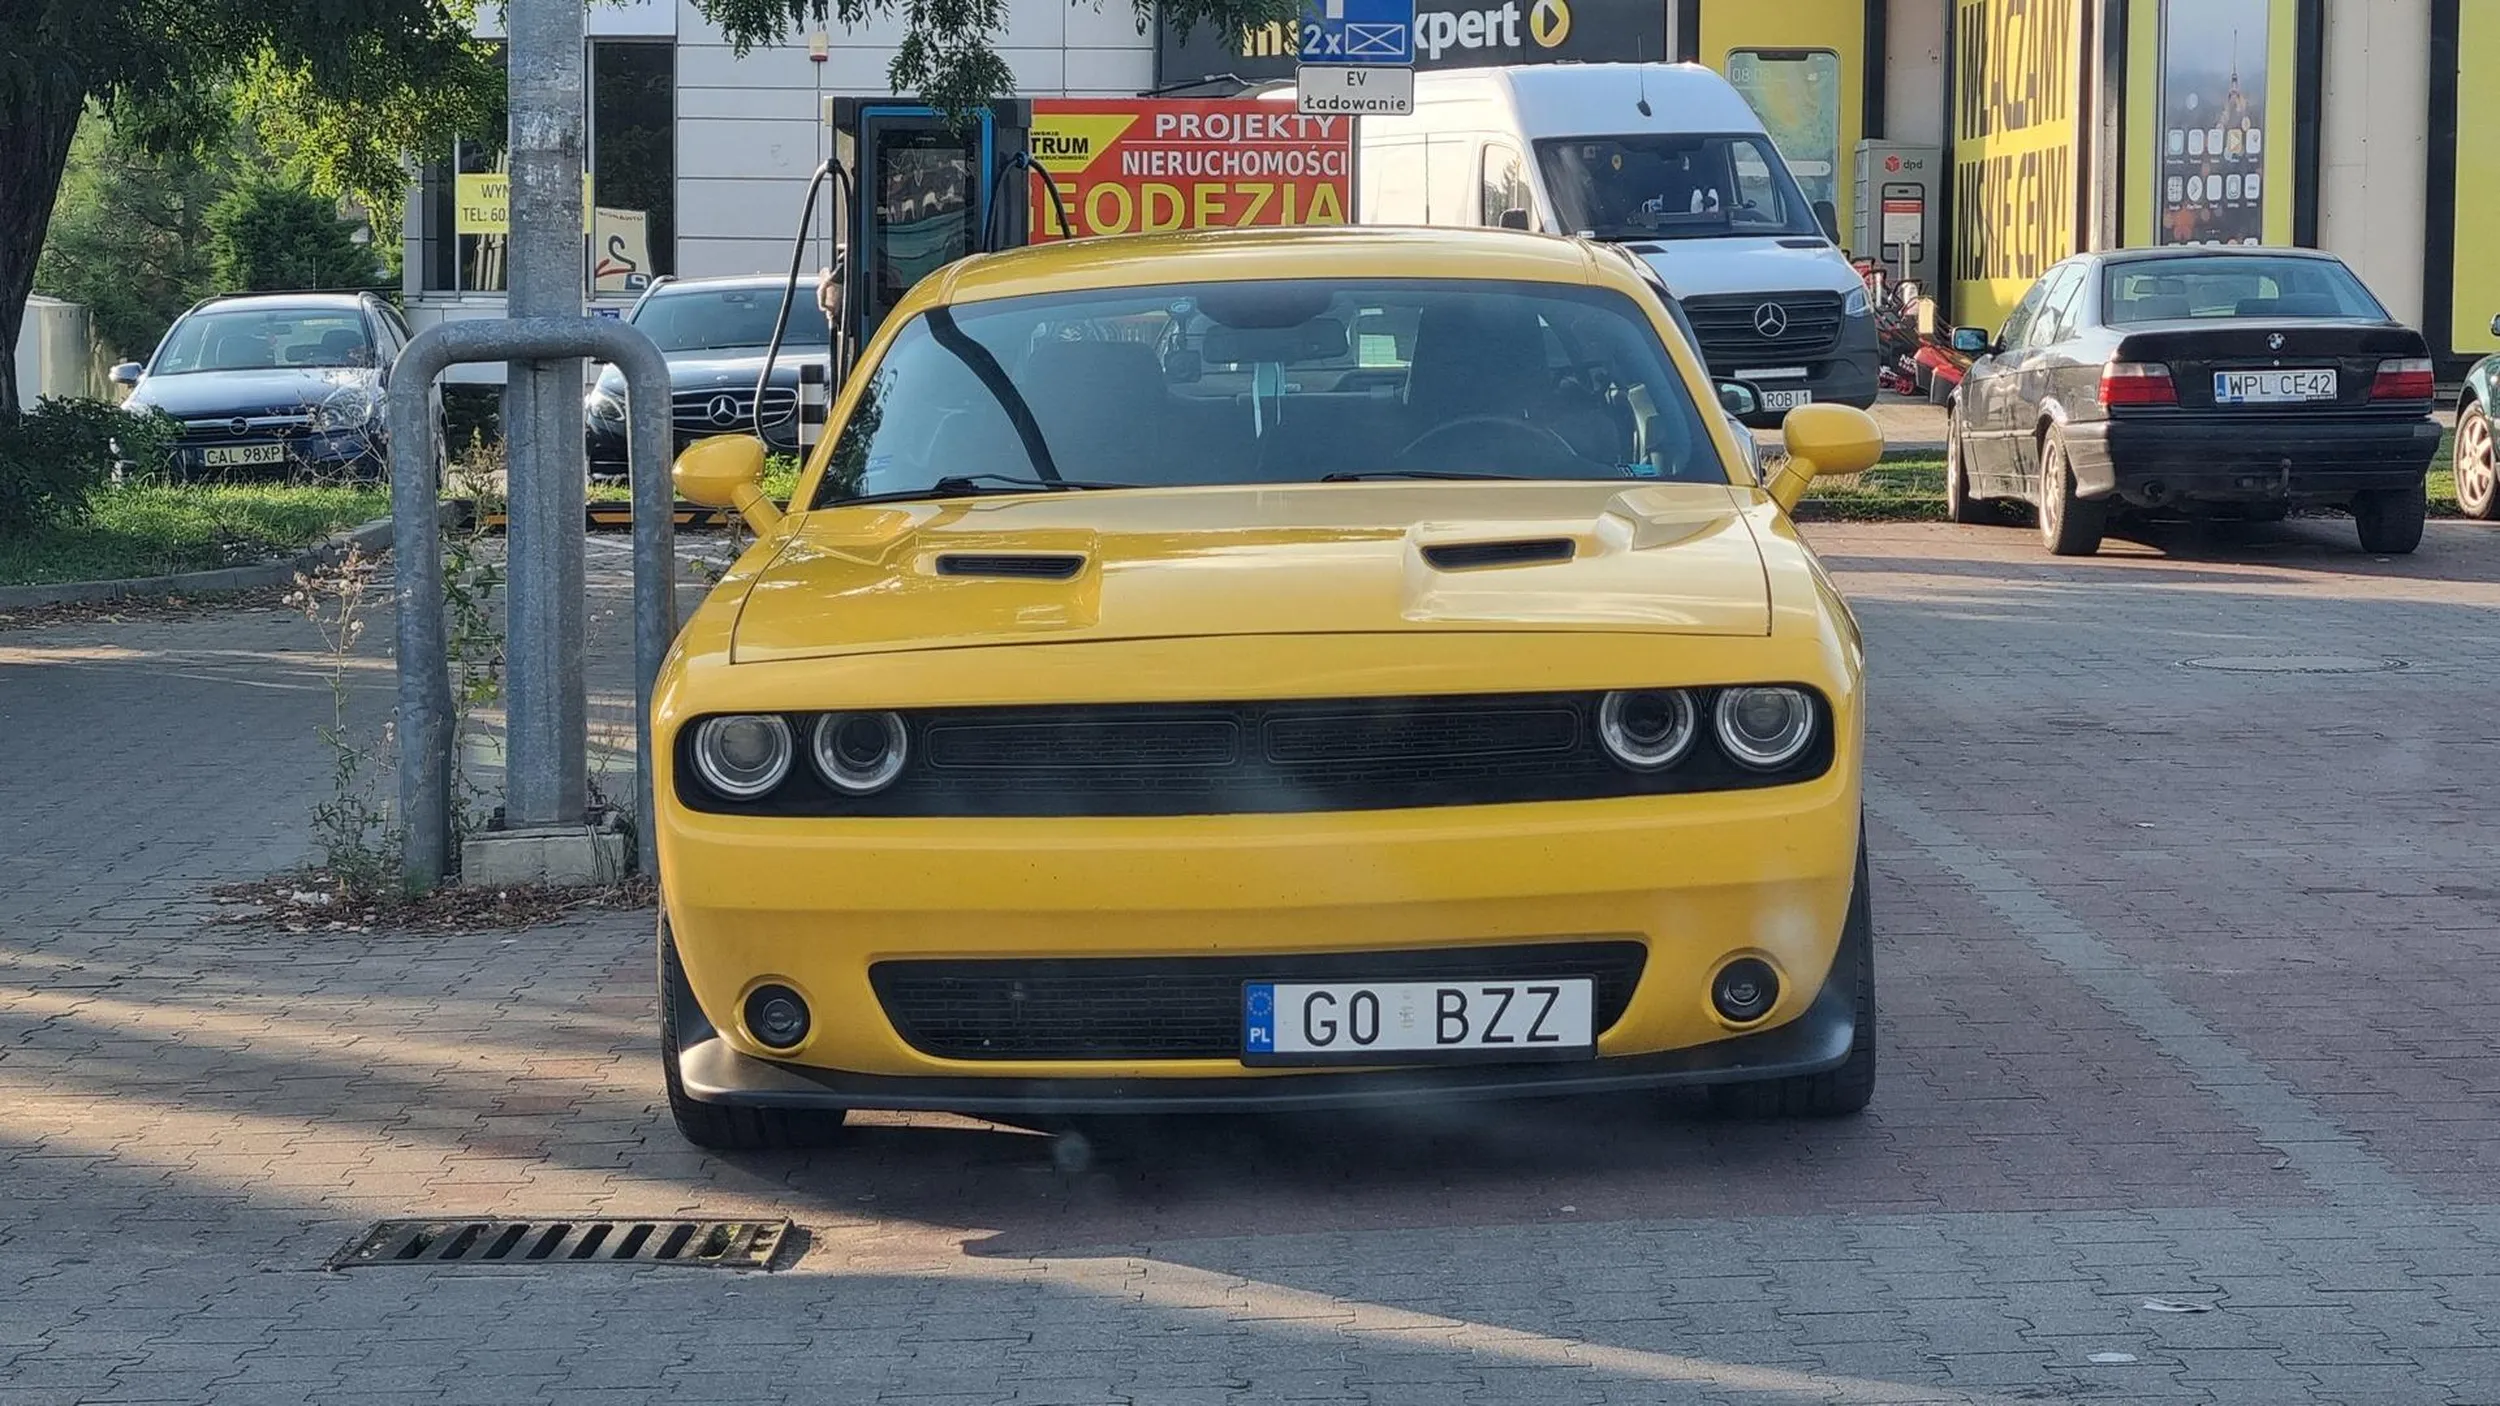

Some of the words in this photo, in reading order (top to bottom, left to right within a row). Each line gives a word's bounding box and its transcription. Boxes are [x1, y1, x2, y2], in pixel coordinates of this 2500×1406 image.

[1304, 25, 1342, 55] 2x
[1347, 72, 1367, 86] EV
[1305, 94, 1406, 111] Ładowanie
[1155, 114, 1333, 143] PROJEKTY
[1122, 146, 1346, 177] NIERUCHOMOŚCI
[1903, 158, 1923, 171] dpd
[463, 208, 487, 222] TEL:
[491, 208, 509, 222] 60
[1029, 182, 1345, 236] EODEZIA
[1957, 155, 2013, 280] NISKIE
[2015, 145, 2067, 280] CENY!
[2229, 375, 2271, 395] WPL
[2280, 373, 2331, 395] CE42
[207, 449, 237, 464] CAL
[243, 446, 280, 462] 98XP
[1436, 985, 1560, 1044] BZZ
[1250, 1027, 1270, 1043] PL
